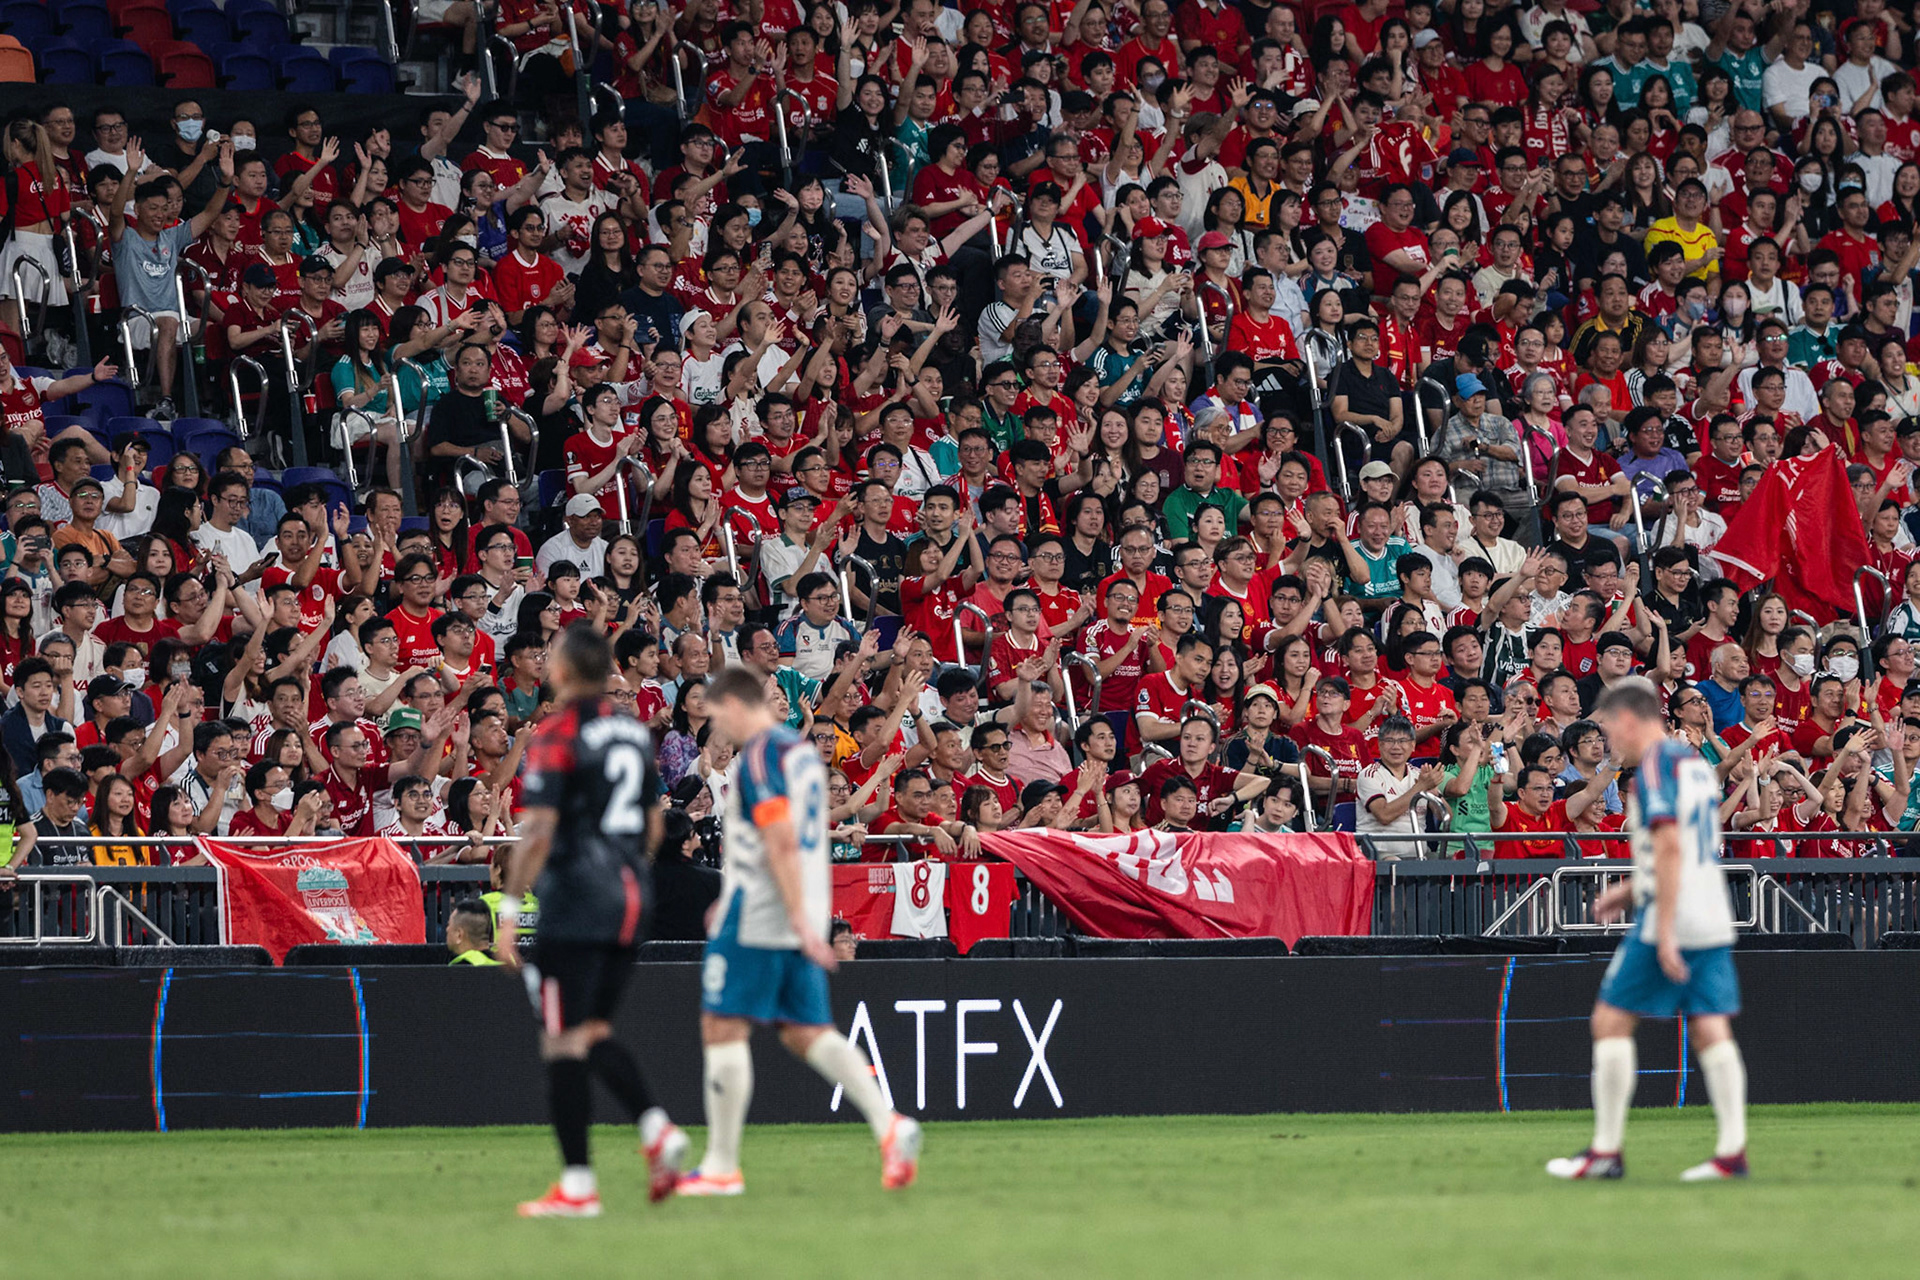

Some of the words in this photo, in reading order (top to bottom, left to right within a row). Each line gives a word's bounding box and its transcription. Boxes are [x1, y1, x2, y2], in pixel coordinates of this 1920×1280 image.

[1526, 138, 1544, 148] 8
[411, 647, 440, 657] Standard
[601, 745, 645, 836] 2
[308, 897, 347, 908] LIVERPOOL
[911, 862, 931, 909] 8
[971, 864, 990, 915] 8
[831, 998, 1064, 1111] ATFX
